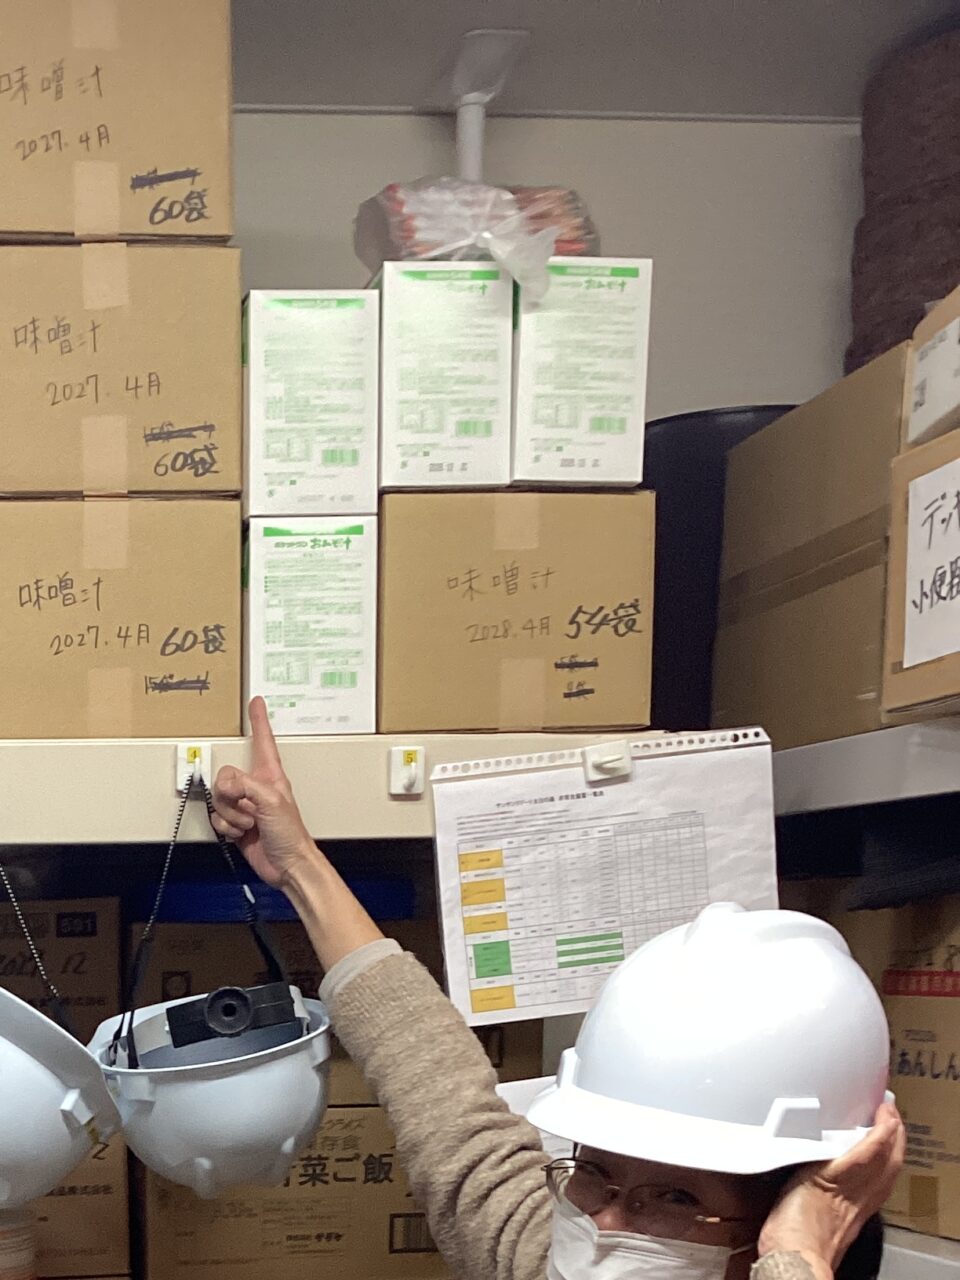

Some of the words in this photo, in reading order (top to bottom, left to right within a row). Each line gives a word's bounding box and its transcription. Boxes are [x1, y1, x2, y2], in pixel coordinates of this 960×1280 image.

[14, 316, 103, 356] 味噌汁
[18, 571, 103, 611] 味噌汁
[446, 560, 557, 600] 味噌汁
[283, 1152, 394, 1188] 菜ご飯
